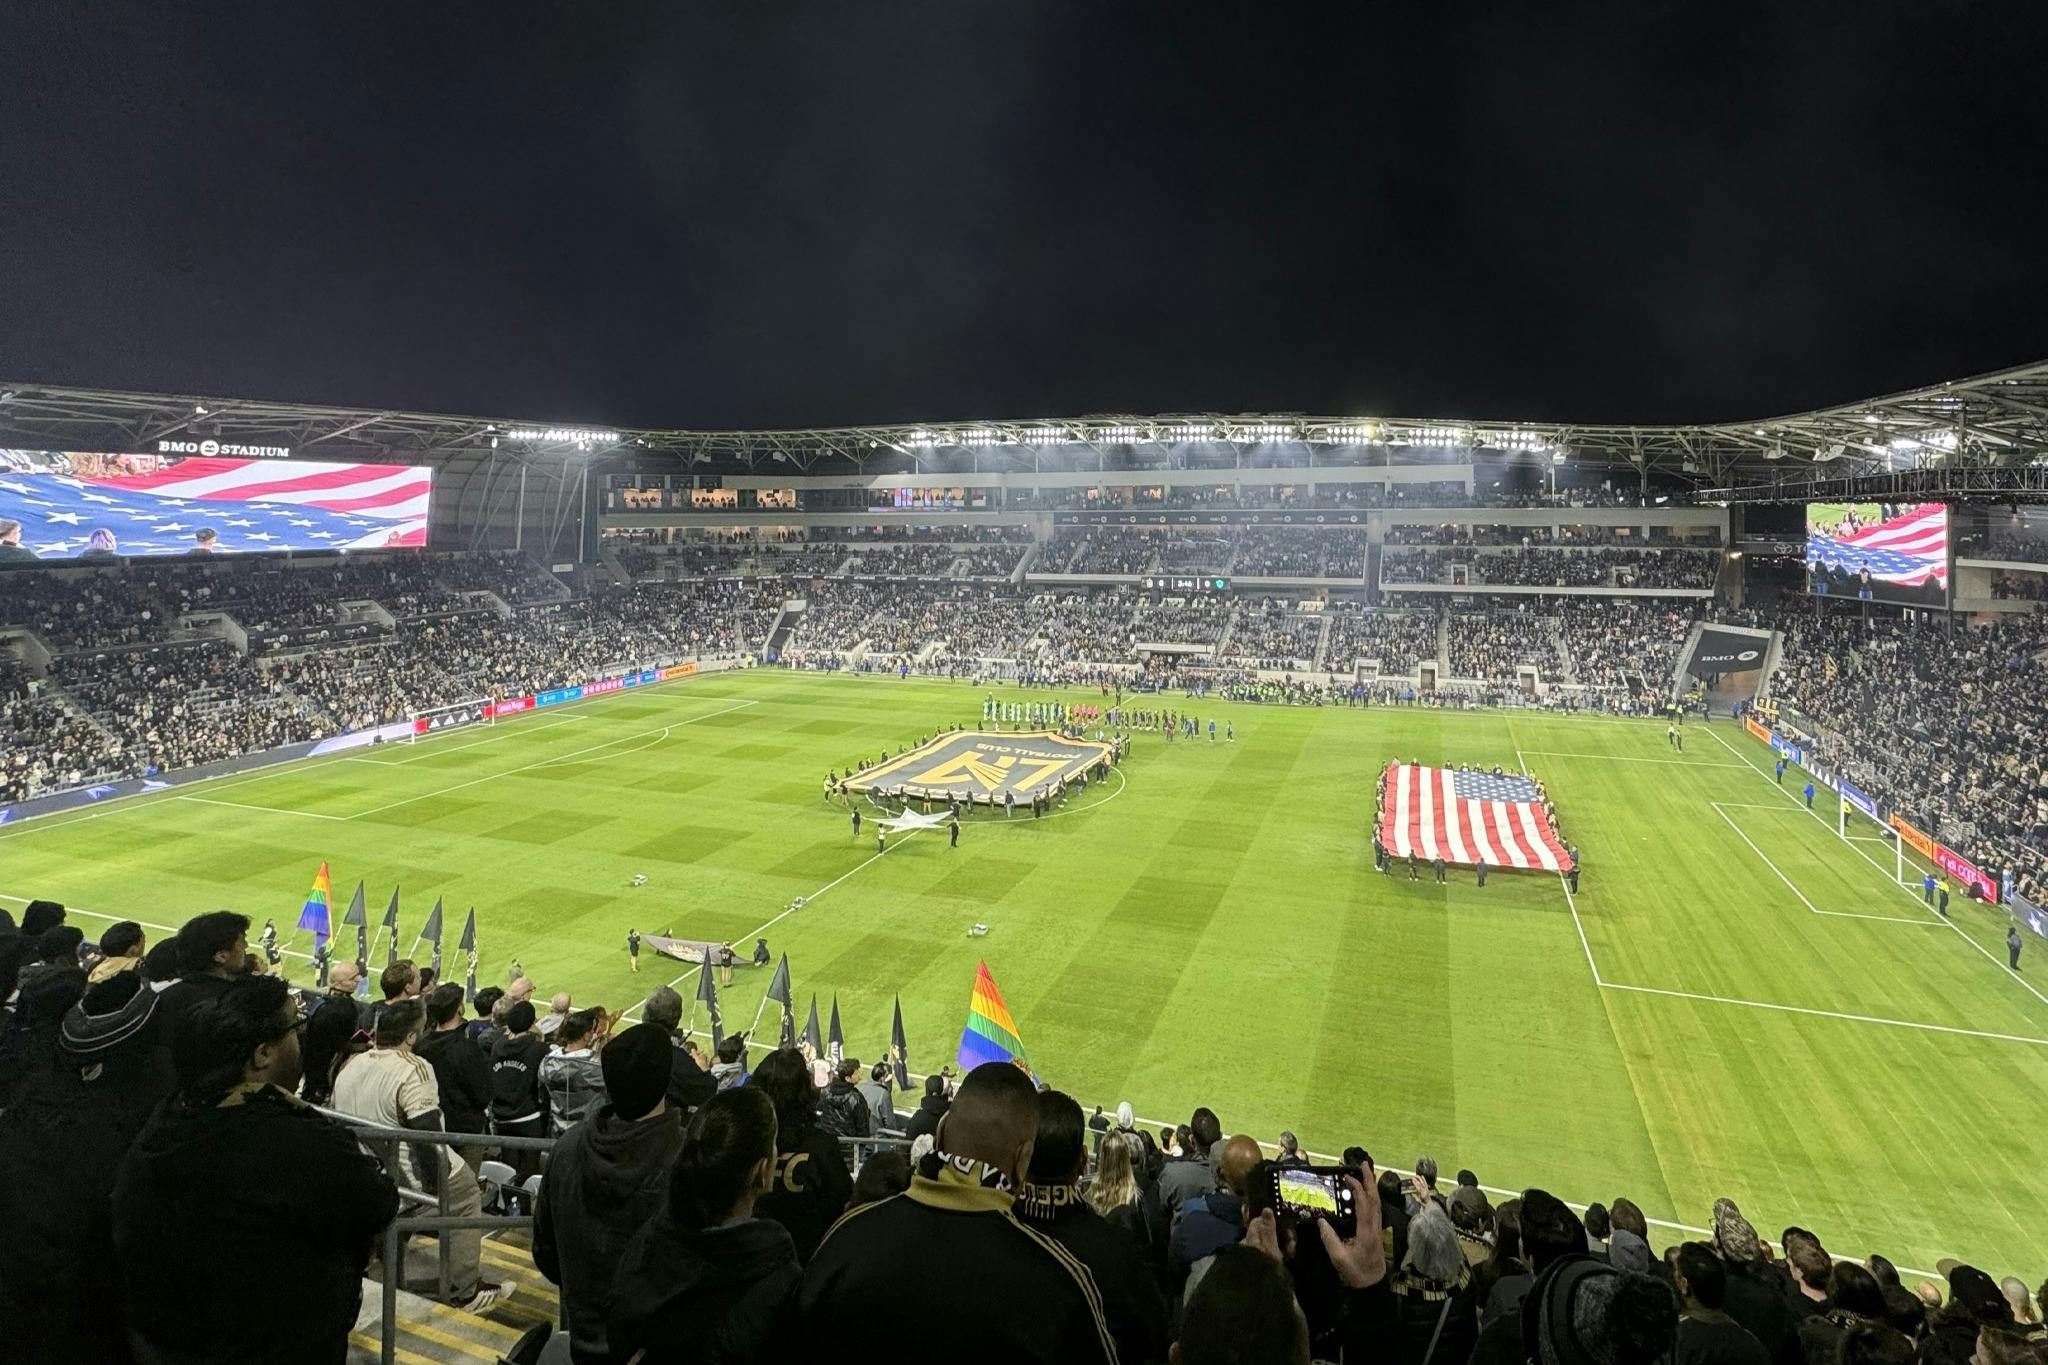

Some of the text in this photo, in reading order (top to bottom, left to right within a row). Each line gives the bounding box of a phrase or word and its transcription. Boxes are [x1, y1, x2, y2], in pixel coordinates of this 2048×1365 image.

[158, 440, 290, 457] BMO STADIUM
[976, 743, 1012, 753] CLUB
